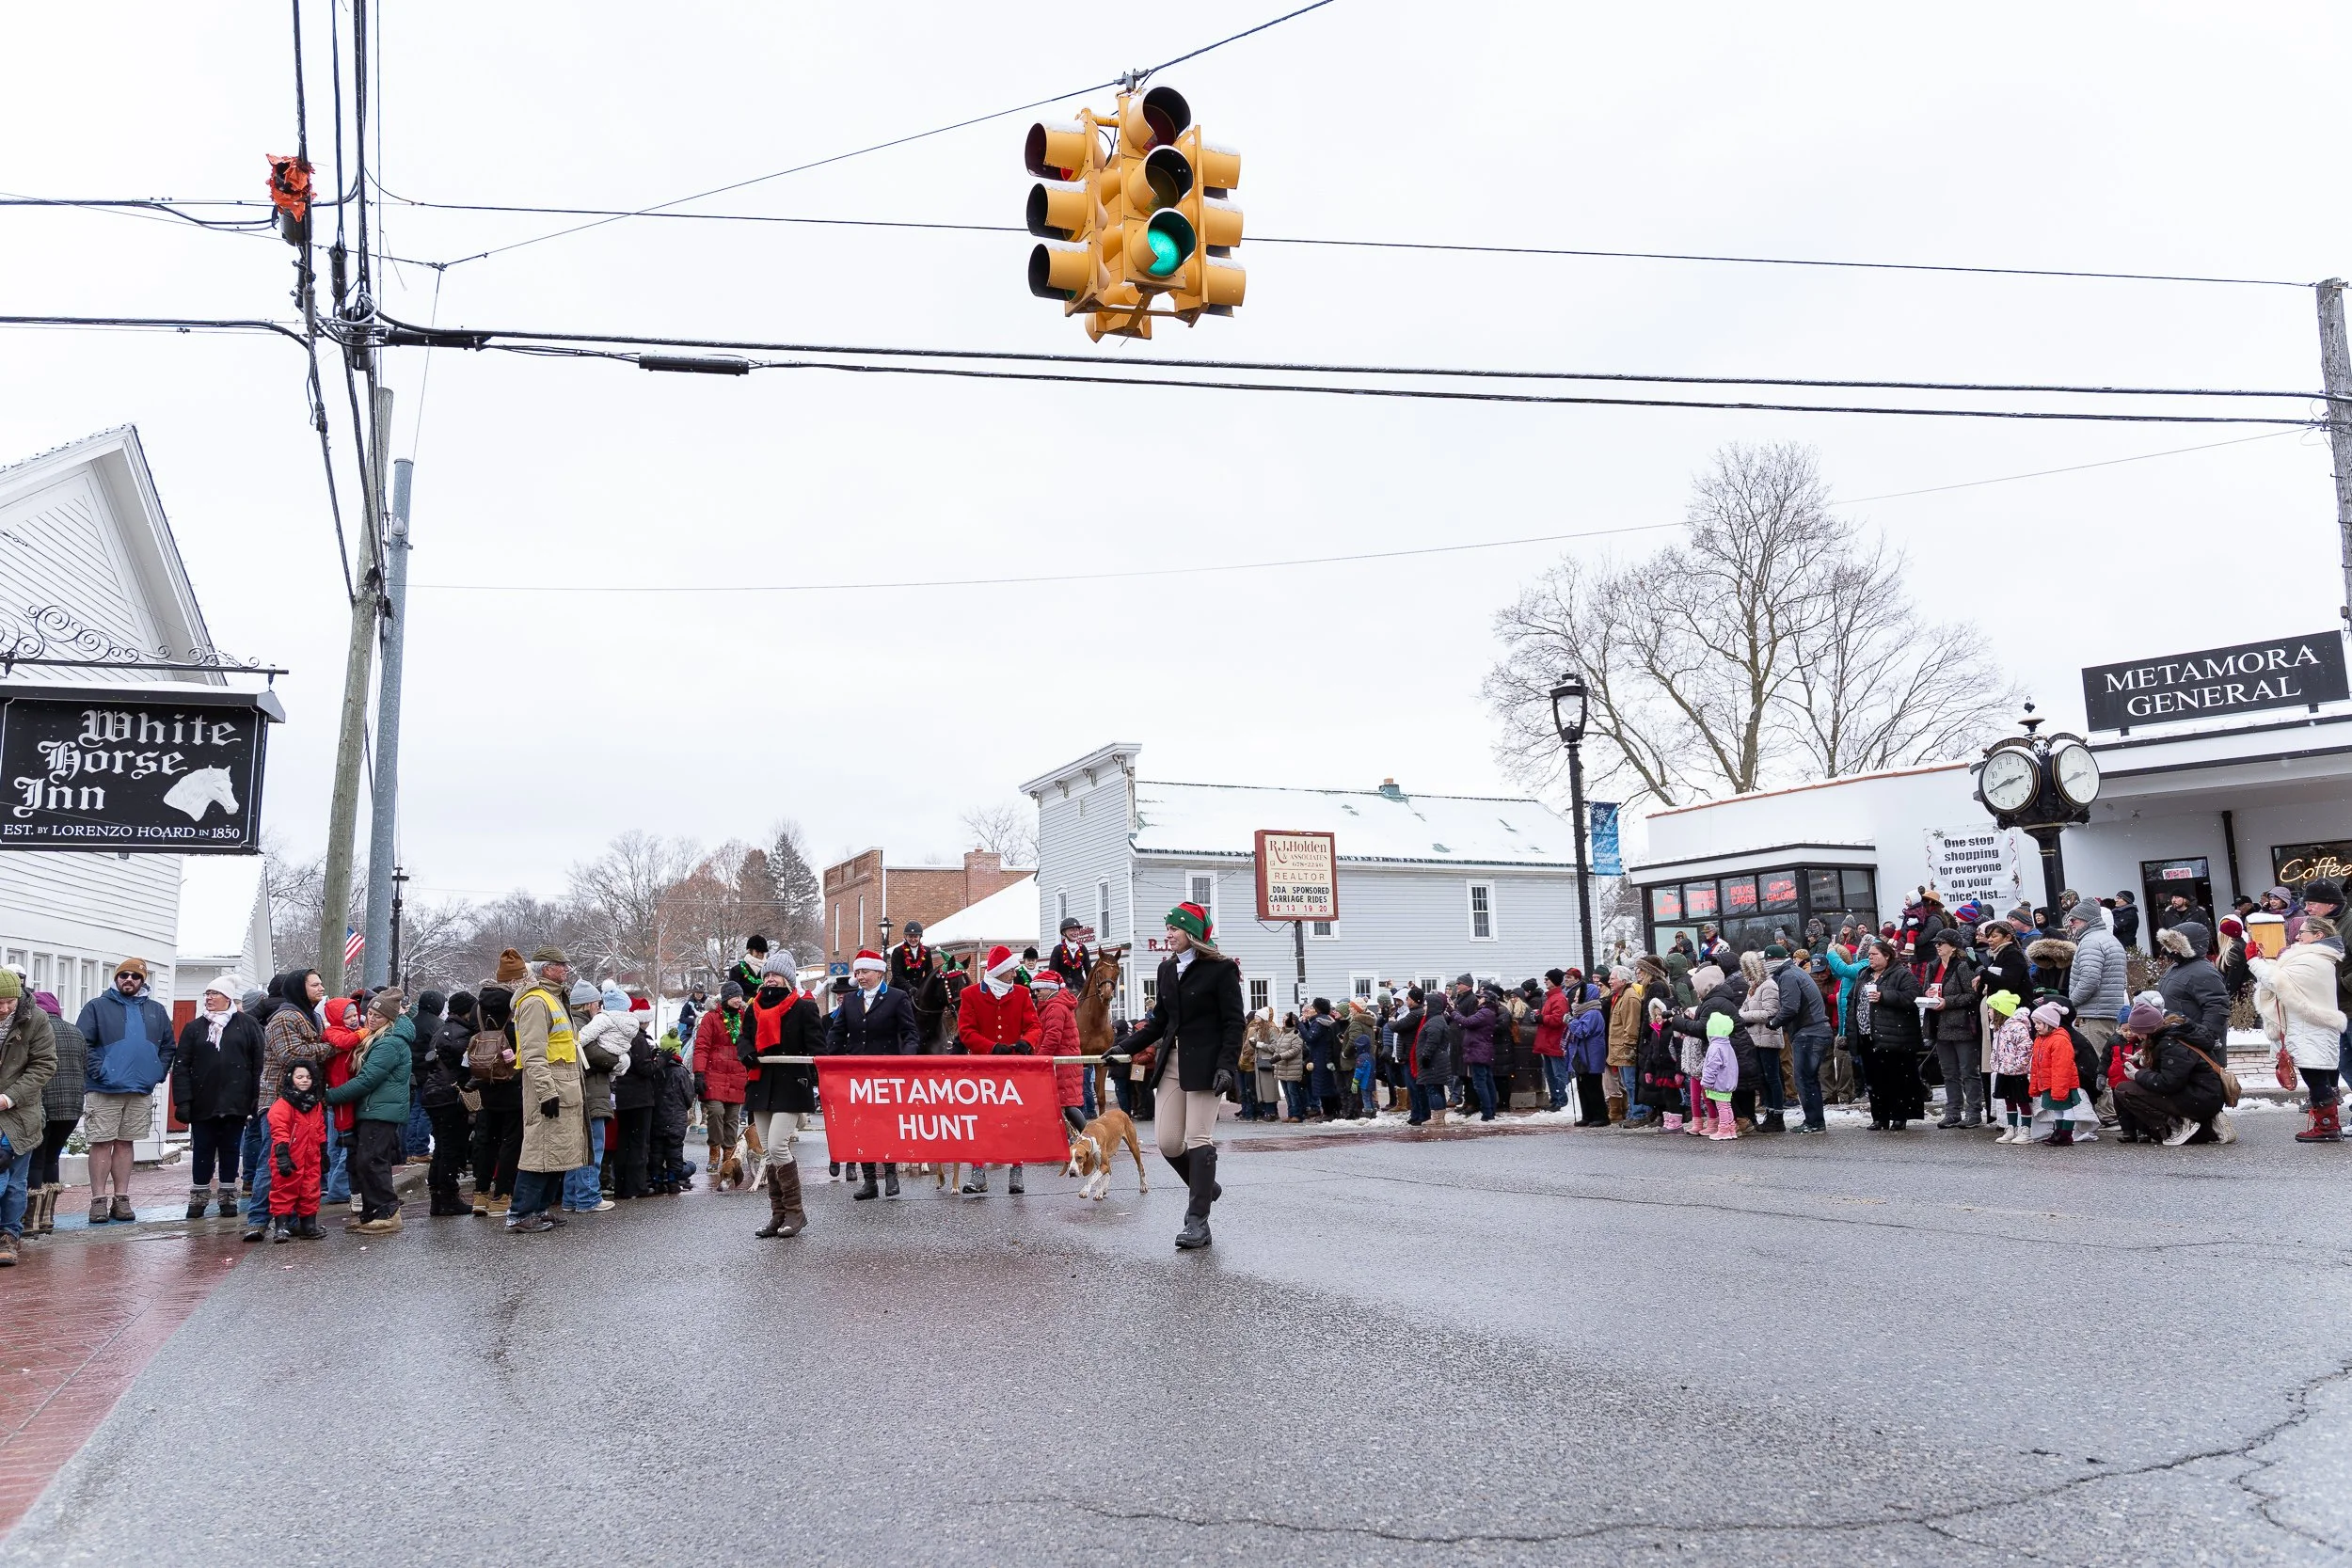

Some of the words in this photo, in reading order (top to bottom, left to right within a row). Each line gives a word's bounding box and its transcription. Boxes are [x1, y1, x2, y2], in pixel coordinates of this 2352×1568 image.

[2106, 644, 2321, 693] METAMORA
[2127, 676, 2301, 717] GENERAL
[78, 709, 242, 748] White
[37, 740, 188, 784] Horse
[13, 776, 105, 818] Inn
[3, 824, 34, 835] EST.
[52, 824, 133, 837] LORENZO
[137, 827, 196, 838] HOARD
[211, 827, 240, 839] 1850
[1944, 838, 1966, 848] One
[1968, 836, 1994, 847] stop
[1944, 848, 1999, 862] shopping
[1939, 865, 1953, 876] for
[1955, 863, 2002, 874] everyone
[2280, 856, 2352, 882] Coffee
[1274, 872, 1326, 880] REALTOR
[1730, 883, 1756, 896] BOOKS
[1769, 879, 1792, 892] GIFTS
[1951, 879, 1965, 889] on
[1967, 877, 1993, 889] your
[1272, 885, 1287, 894] DDA
[1292, 886, 1329, 895] SPONSORED
[1766, 889, 1797, 902] GALORE
[1944, 891, 1977, 902] "nice"
[1979, 890, 2007, 900] list...
[1269, 895, 1304, 903] CARRIAGE
[1731, 895, 1756, 906] CARDS
[850, 1078, 1024, 1105] METAMORA
[898, 1114, 978, 1141] HUNT
